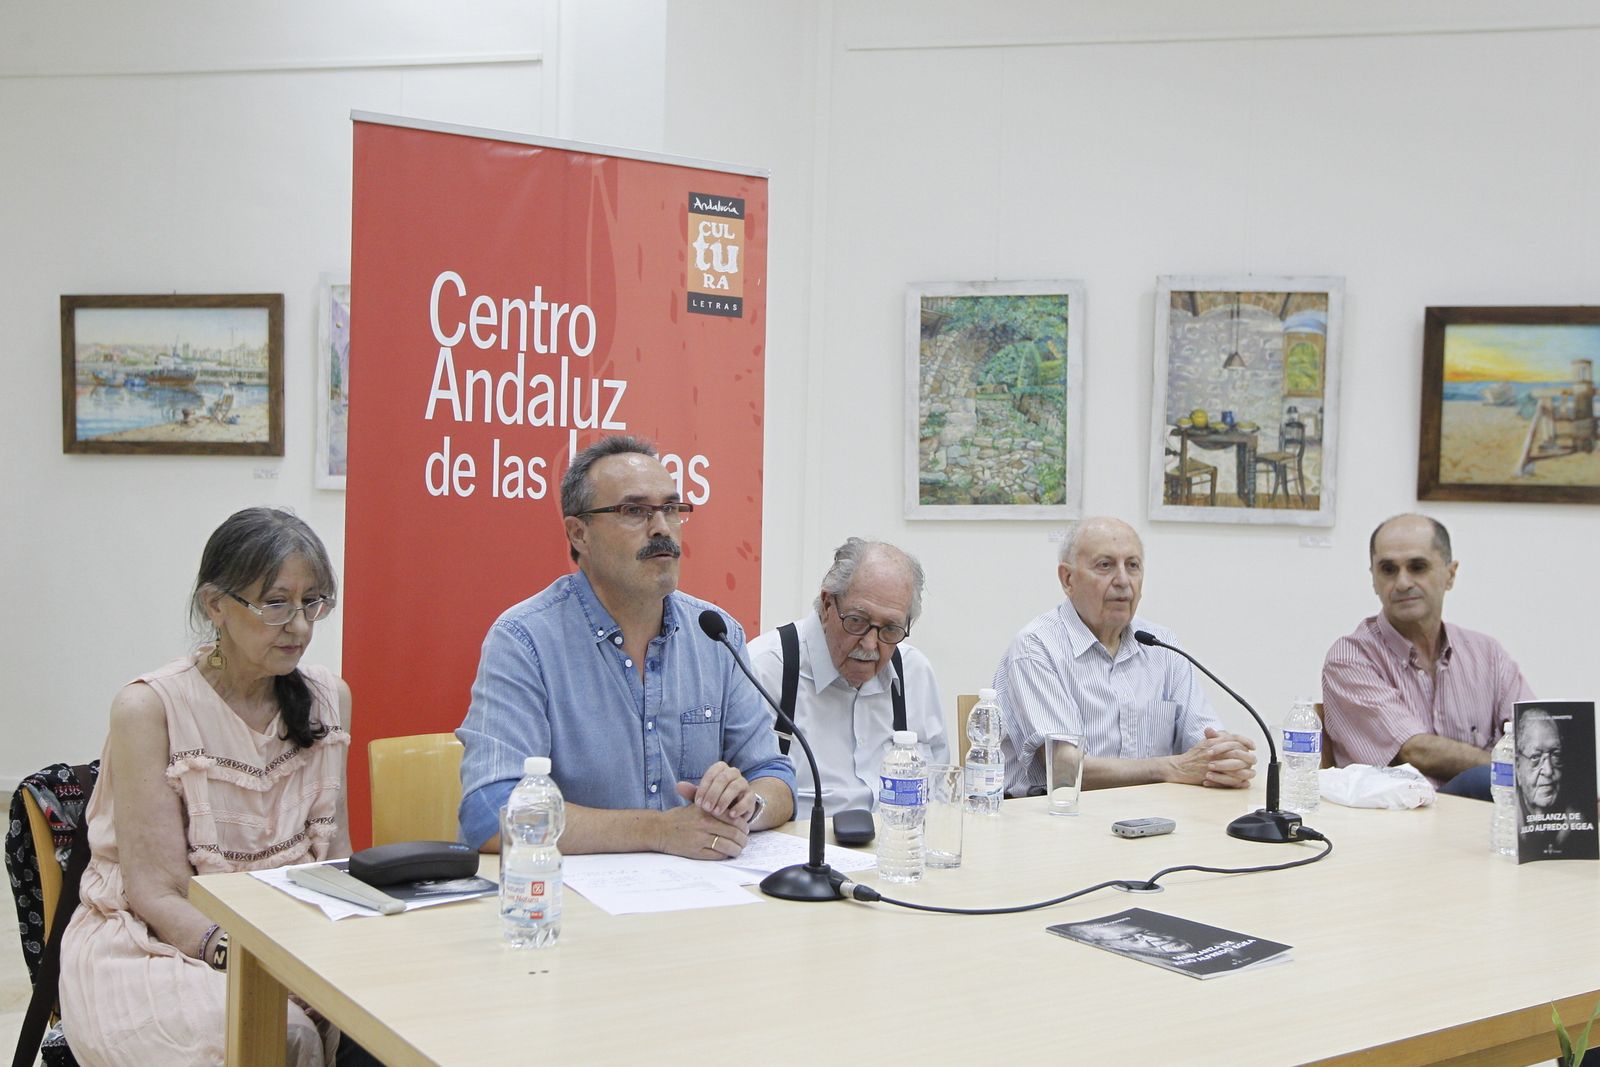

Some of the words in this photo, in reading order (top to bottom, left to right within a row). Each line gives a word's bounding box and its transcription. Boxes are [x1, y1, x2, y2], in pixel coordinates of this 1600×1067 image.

[693, 197, 739, 215] Andalucía
[703, 272, 730, 290] RA
[429, 270, 597, 357] Centro
[692, 299, 738, 311] LETRAS
[424, 346, 628, 430] Andaluz
[425, 436, 476, 498] de
[492, 438, 547, 500] las
[1568, 812, 1581, 820] DE
[1535, 823, 1569, 832] ALFREDO
[1570, 822, 1594, 831] EGEA
